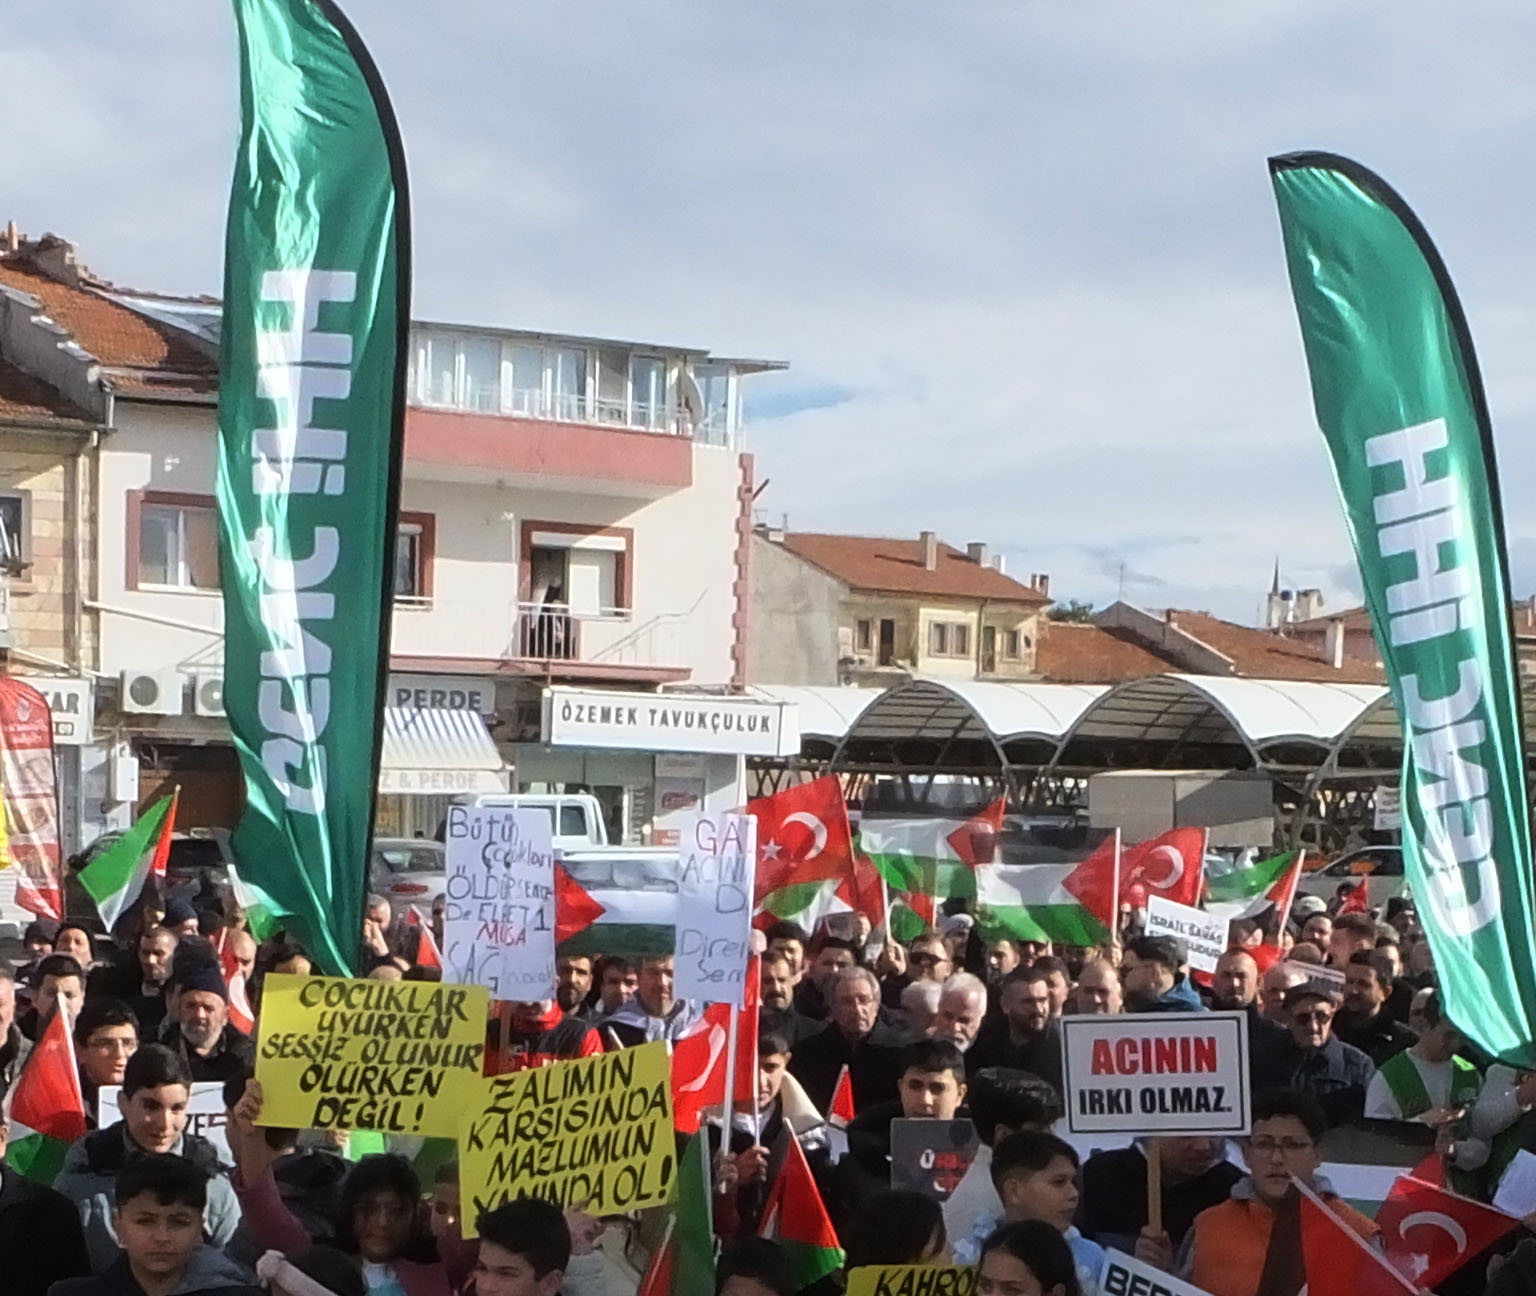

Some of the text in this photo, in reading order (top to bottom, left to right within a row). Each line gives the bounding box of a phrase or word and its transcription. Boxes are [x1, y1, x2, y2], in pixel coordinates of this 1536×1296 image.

[396, 688, 482, 710] PERDE
[561, 700, 772, 735] ÖZEMEK TAVUKÇULUK
[317, 1010, 454, 1041] UYURKEN
[361, 1038, 484, 1073] OLUNUR
[1091, 1036, 1217, 1076] ACININ
[1079, 1086, 1233, 1116] IRKI OLMAZ.
[485, 1119, 657, 1187] MAZLUMUN
